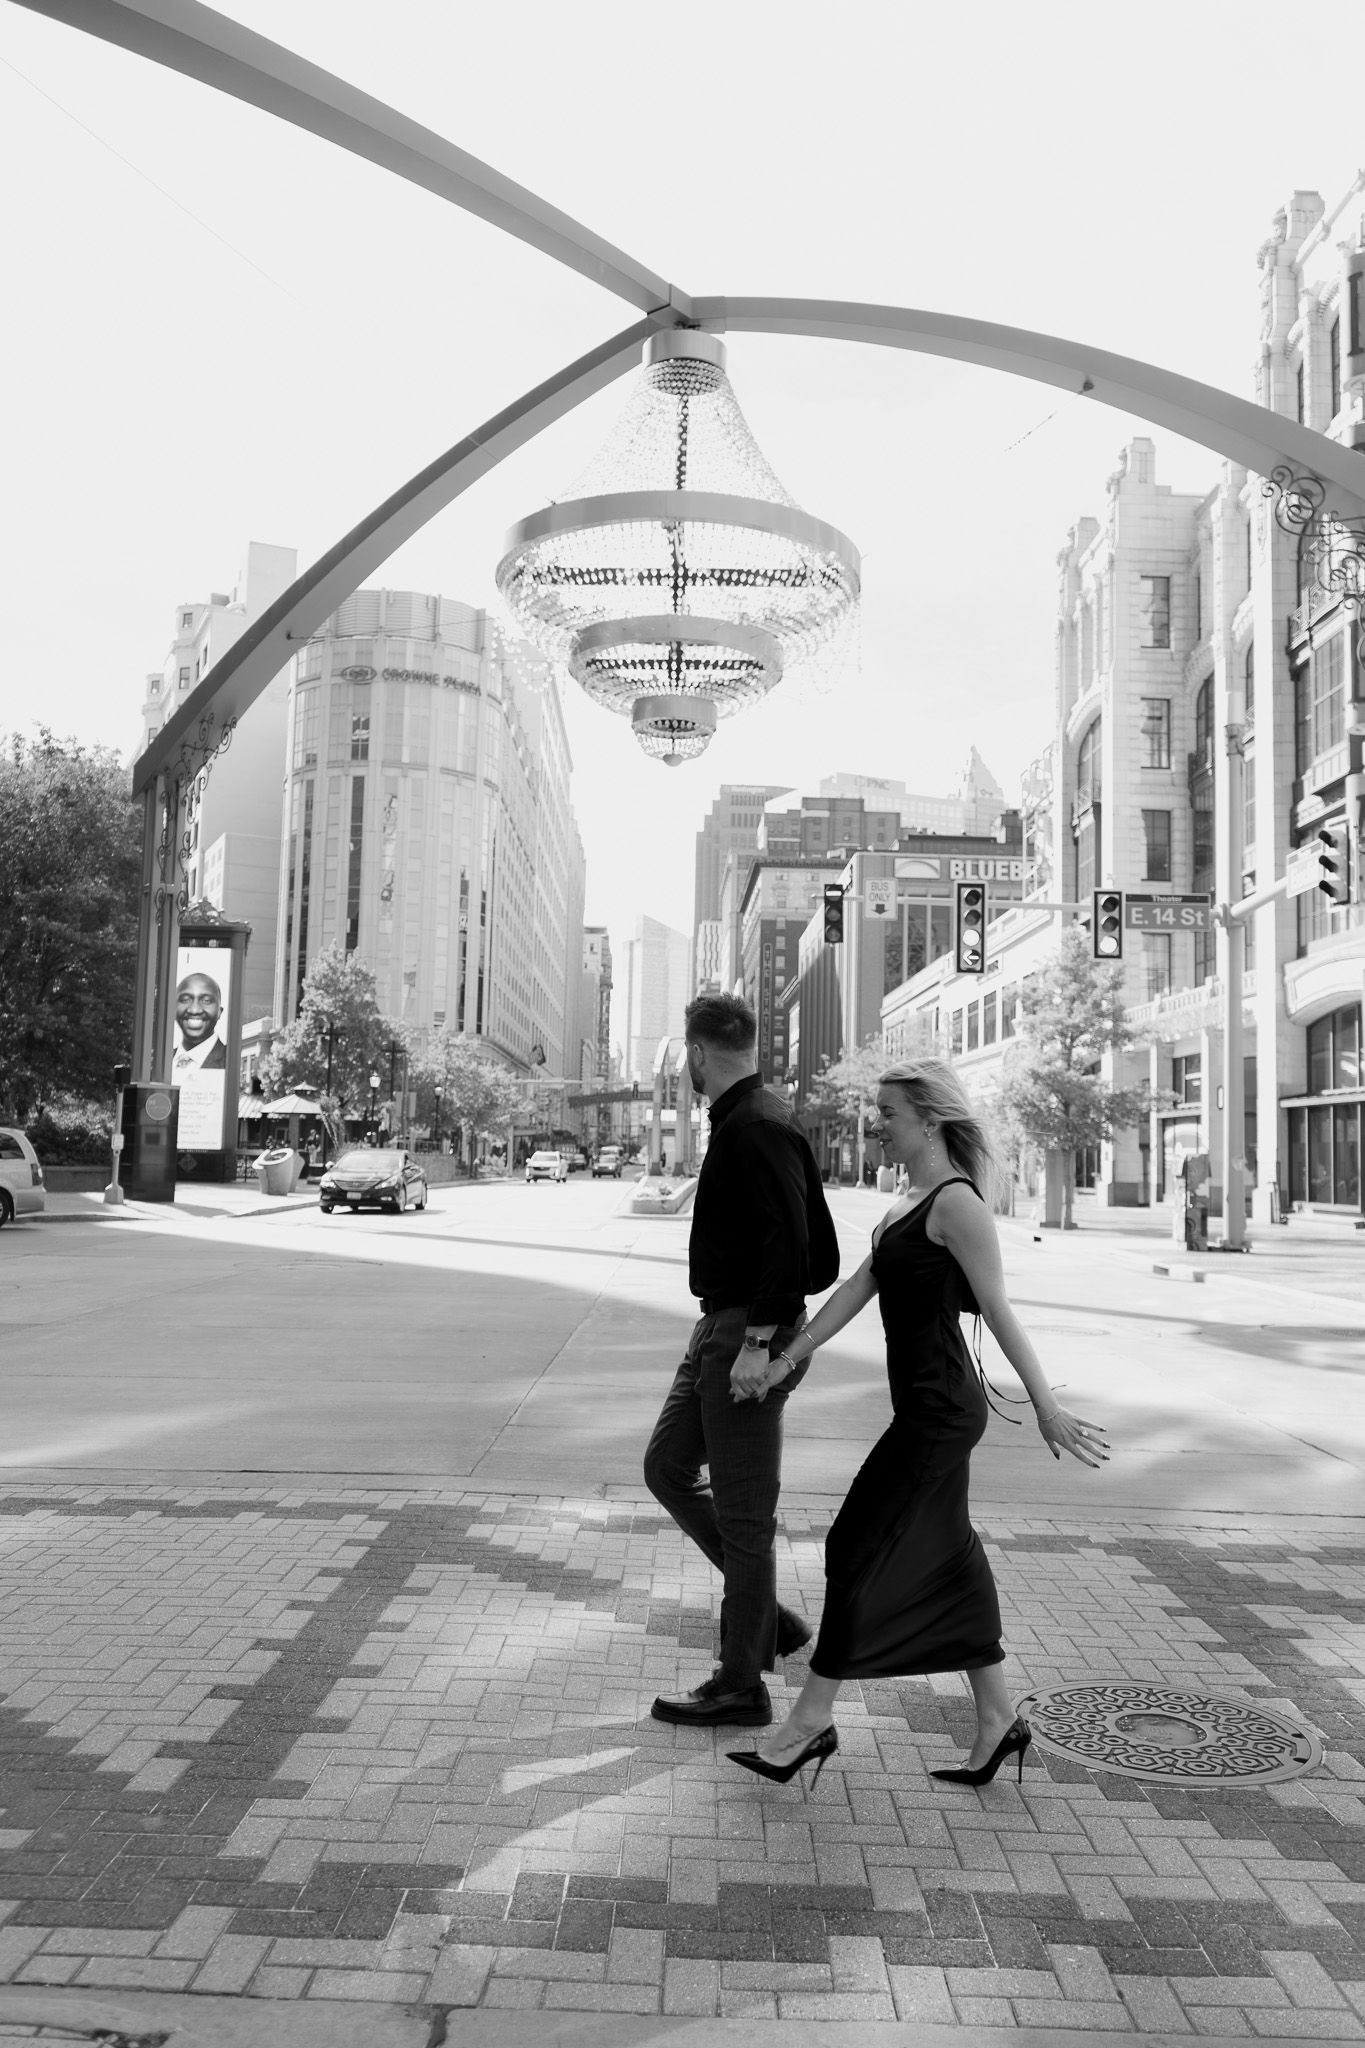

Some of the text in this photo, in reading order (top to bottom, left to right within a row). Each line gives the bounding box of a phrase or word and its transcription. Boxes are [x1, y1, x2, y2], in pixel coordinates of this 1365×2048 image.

[382, 667, 482, 697] CROWNE PLAZA
[866, 777, 890, 791] PNC
[870, 881, 889, 892] BUS
[868, 892, 892, 902] ONLY
[1152, 895, 1183, 903] Theater
[1131, 907, 1204, 926] E. 14 St
